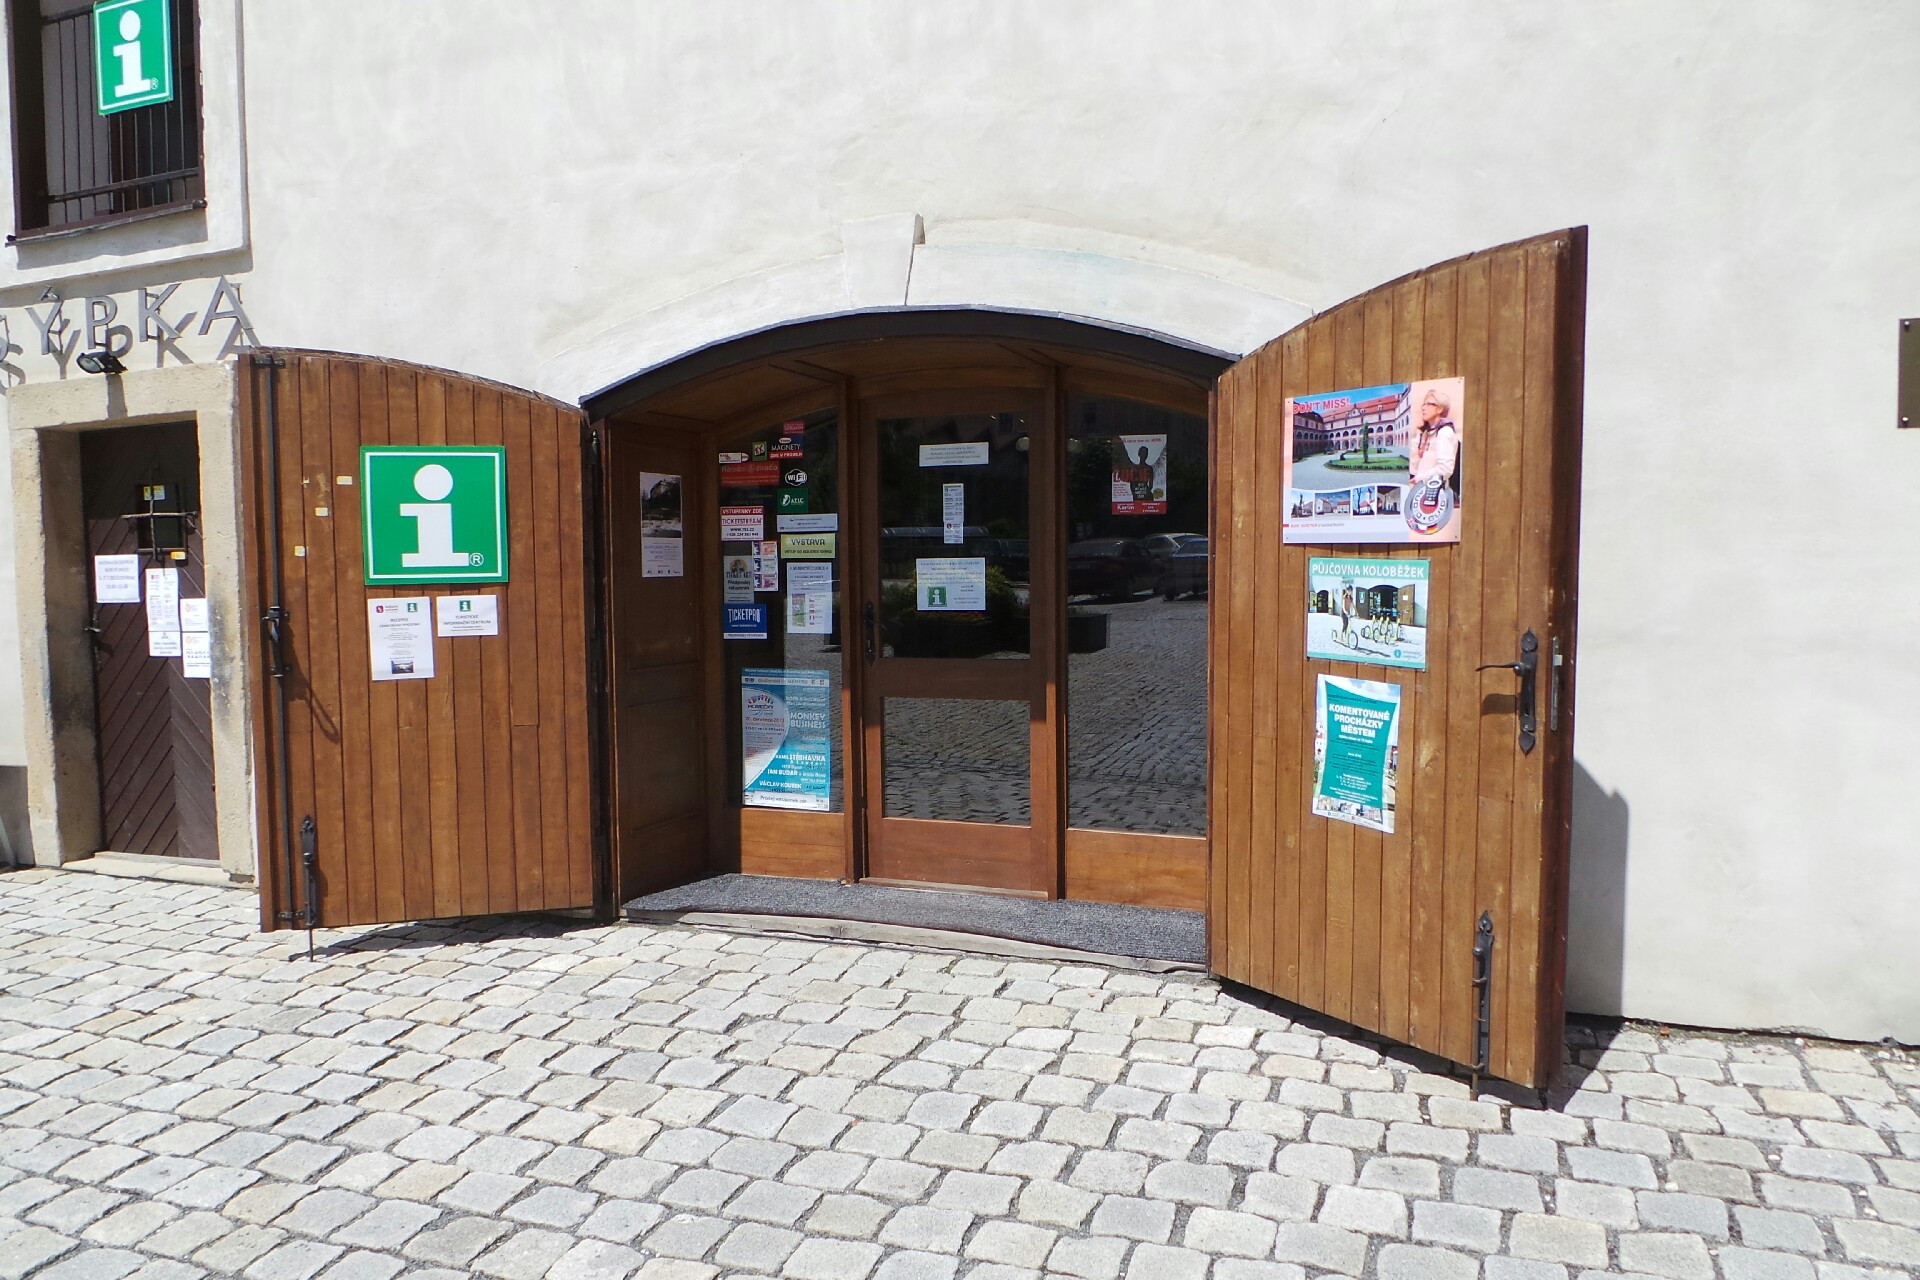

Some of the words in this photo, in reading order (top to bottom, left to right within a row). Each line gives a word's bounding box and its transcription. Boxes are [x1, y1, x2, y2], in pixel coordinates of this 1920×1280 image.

[1293, 401, 1320, 414] DON'T
[1323, 398, 1350, 410] MISS!
[771, 443, 801, 451] MAGNETY
[1312, 561, 1360, 576] PŮJČOVNA
[1363, 564, 1424, 578] KOLOBĚŽEK
[790, 712, 826, 720] MONKEY
[1329, 703, 1390, 721] KOMENTOVANÉ
[790, 720, 826, 729] BUSINESS
[1334, 713, 1383, 730] PROCHÁZKY
[1340, 724, 1375, 739] MĚSTEM
